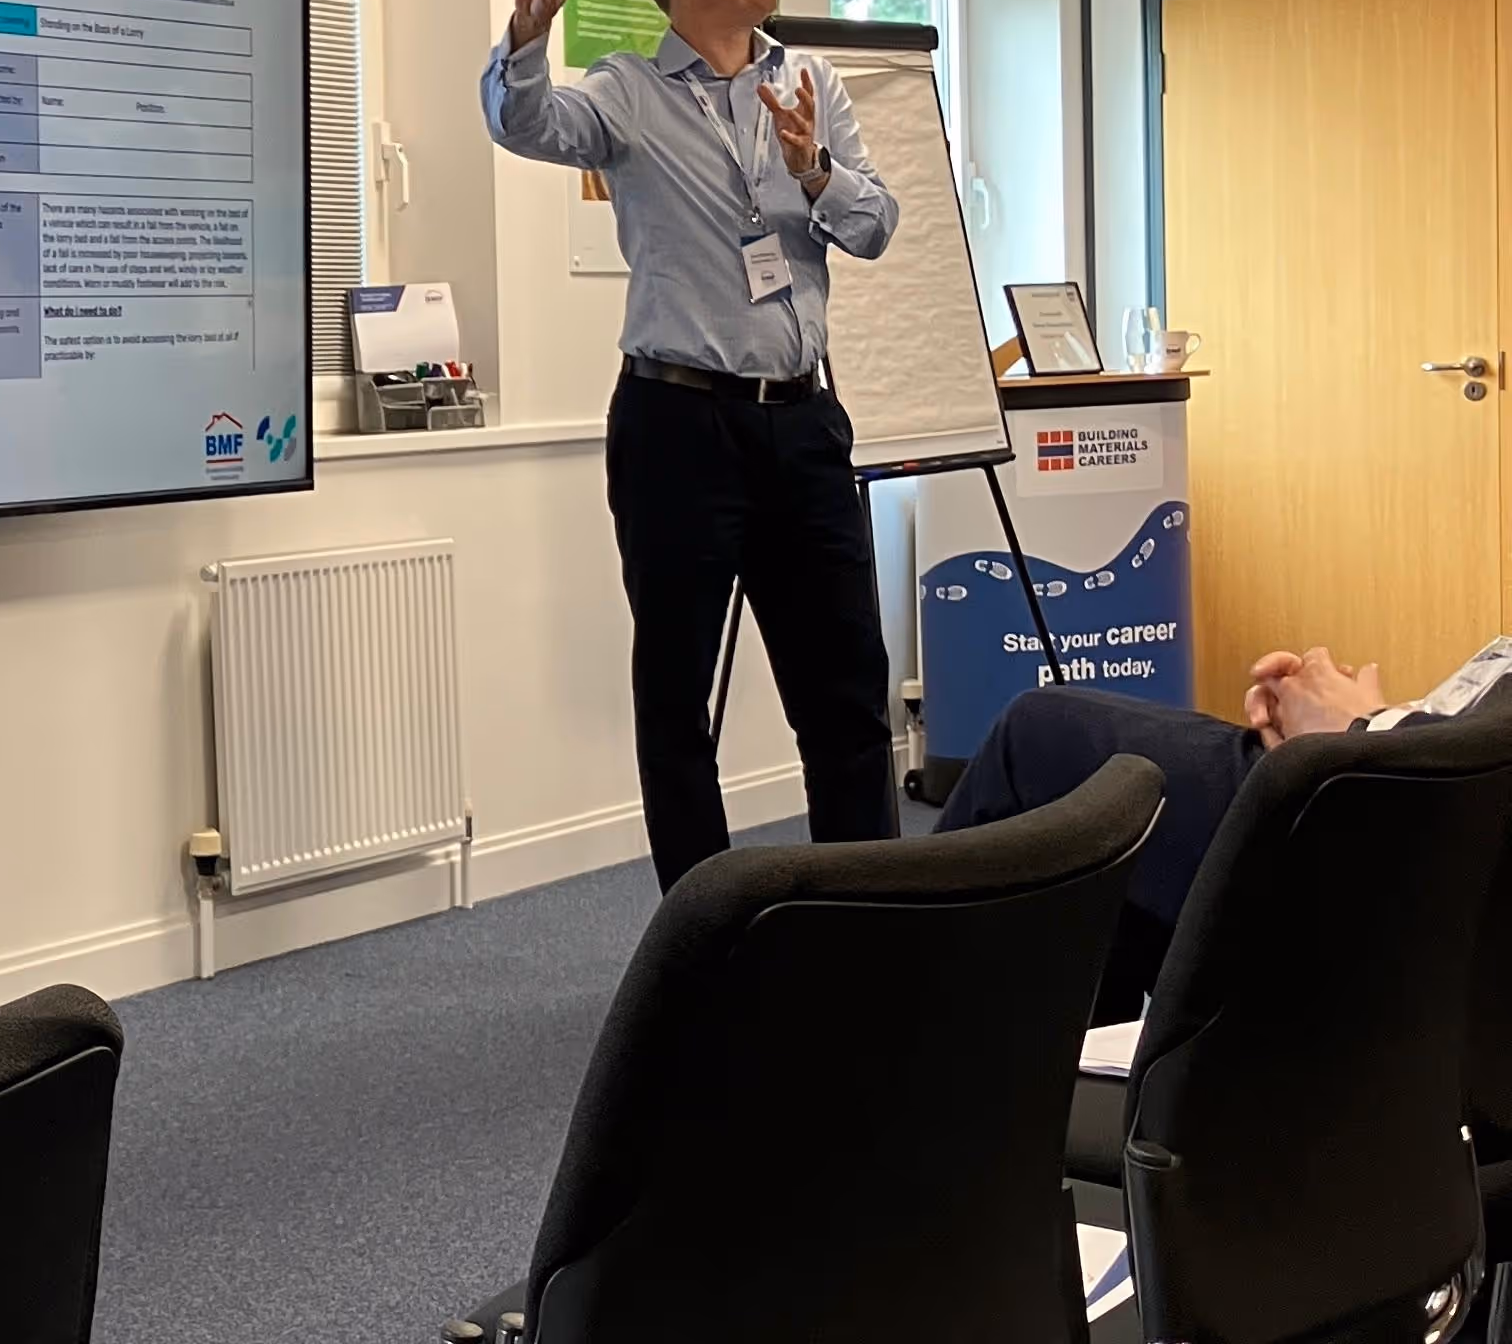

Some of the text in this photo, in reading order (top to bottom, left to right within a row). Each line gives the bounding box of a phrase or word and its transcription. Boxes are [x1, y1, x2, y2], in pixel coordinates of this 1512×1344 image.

[1078, 428, 1139, 442] BUILDING
[205, 433, 244, 456] BMF
[1078, 440, 1149, 454] MATERIALS
[1078, 453, 1137, 467] CAREERS
[1003, 622, 1177, 653] Stat your career
[1103, 657, 1155, 679] today.
